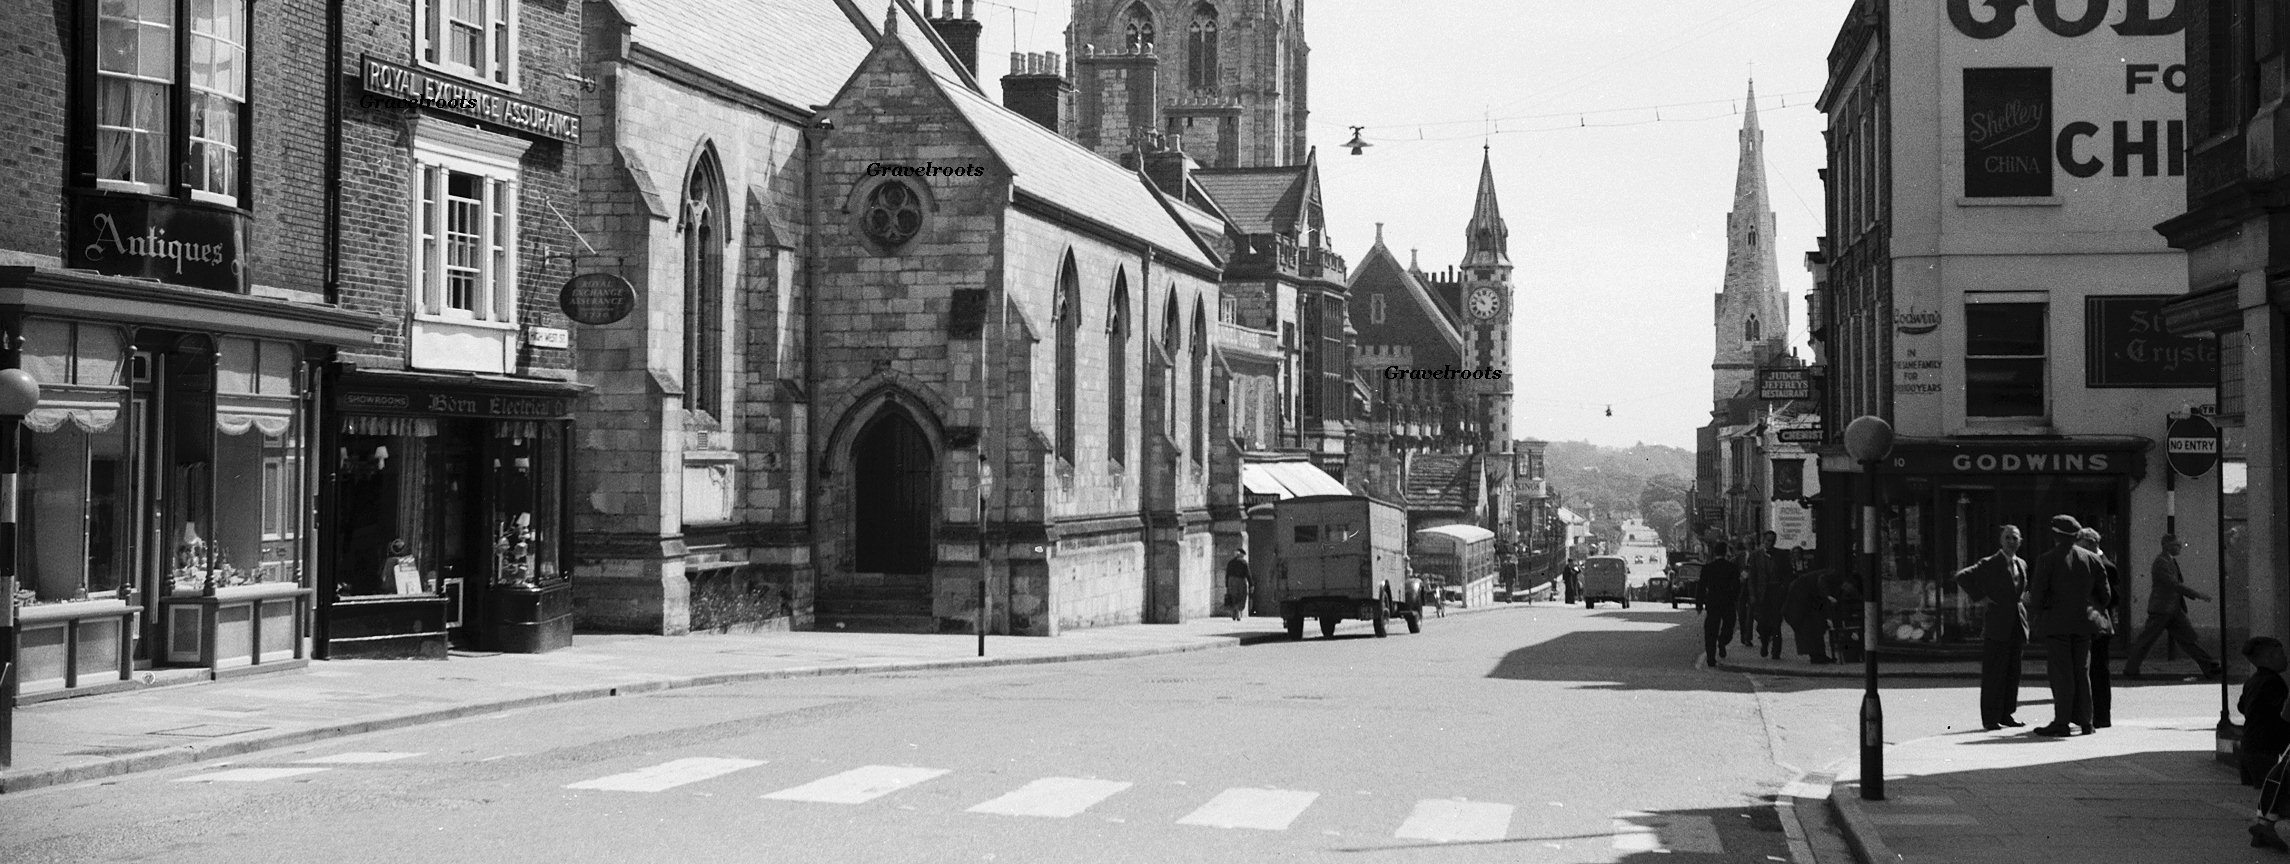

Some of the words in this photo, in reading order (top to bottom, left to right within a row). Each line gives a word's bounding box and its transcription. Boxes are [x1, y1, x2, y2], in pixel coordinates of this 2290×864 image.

[368, 61, 421, 97] ROYAL
[424, 77, 500, 118] EXCHANGE
[503, 100, 579, 138] ASSURANCE
[1969, 100, 2044, 147] Shelley
[2056, 120, 2185, 178] CHI
[1985, 155, 2041, 174] CHINA
[85, 213, 223, 275] Antiques
[582, 280, 612, 288] ROYAL
[571, 288, 624, 297] EXCHANGE
[570, 297, 624, 305] ASSURANCE
[1907, 349, 1916, 357] IN
[1917, 361, 1942, 370] FAMILY
[1768, 372, 1802, 380] JUDGE
[1904, 372, 1918, 380] FOR
[1916, 383, 1942, 392] YEARS
[1761, 389, 1808, 398] RESTAURANT
[346, 394, 407, 405] SHOWROOMS
[428, 394, 477, 413] Born
[1781, 430, 1824, 440] CHEMIST
[2170, 440, 2183, 450] NO
[2185, 440, 2215, 451] ENTRY
[1894, 458, 1905, 468] 10
[1952, 454, 2109, 471] GODWINS
